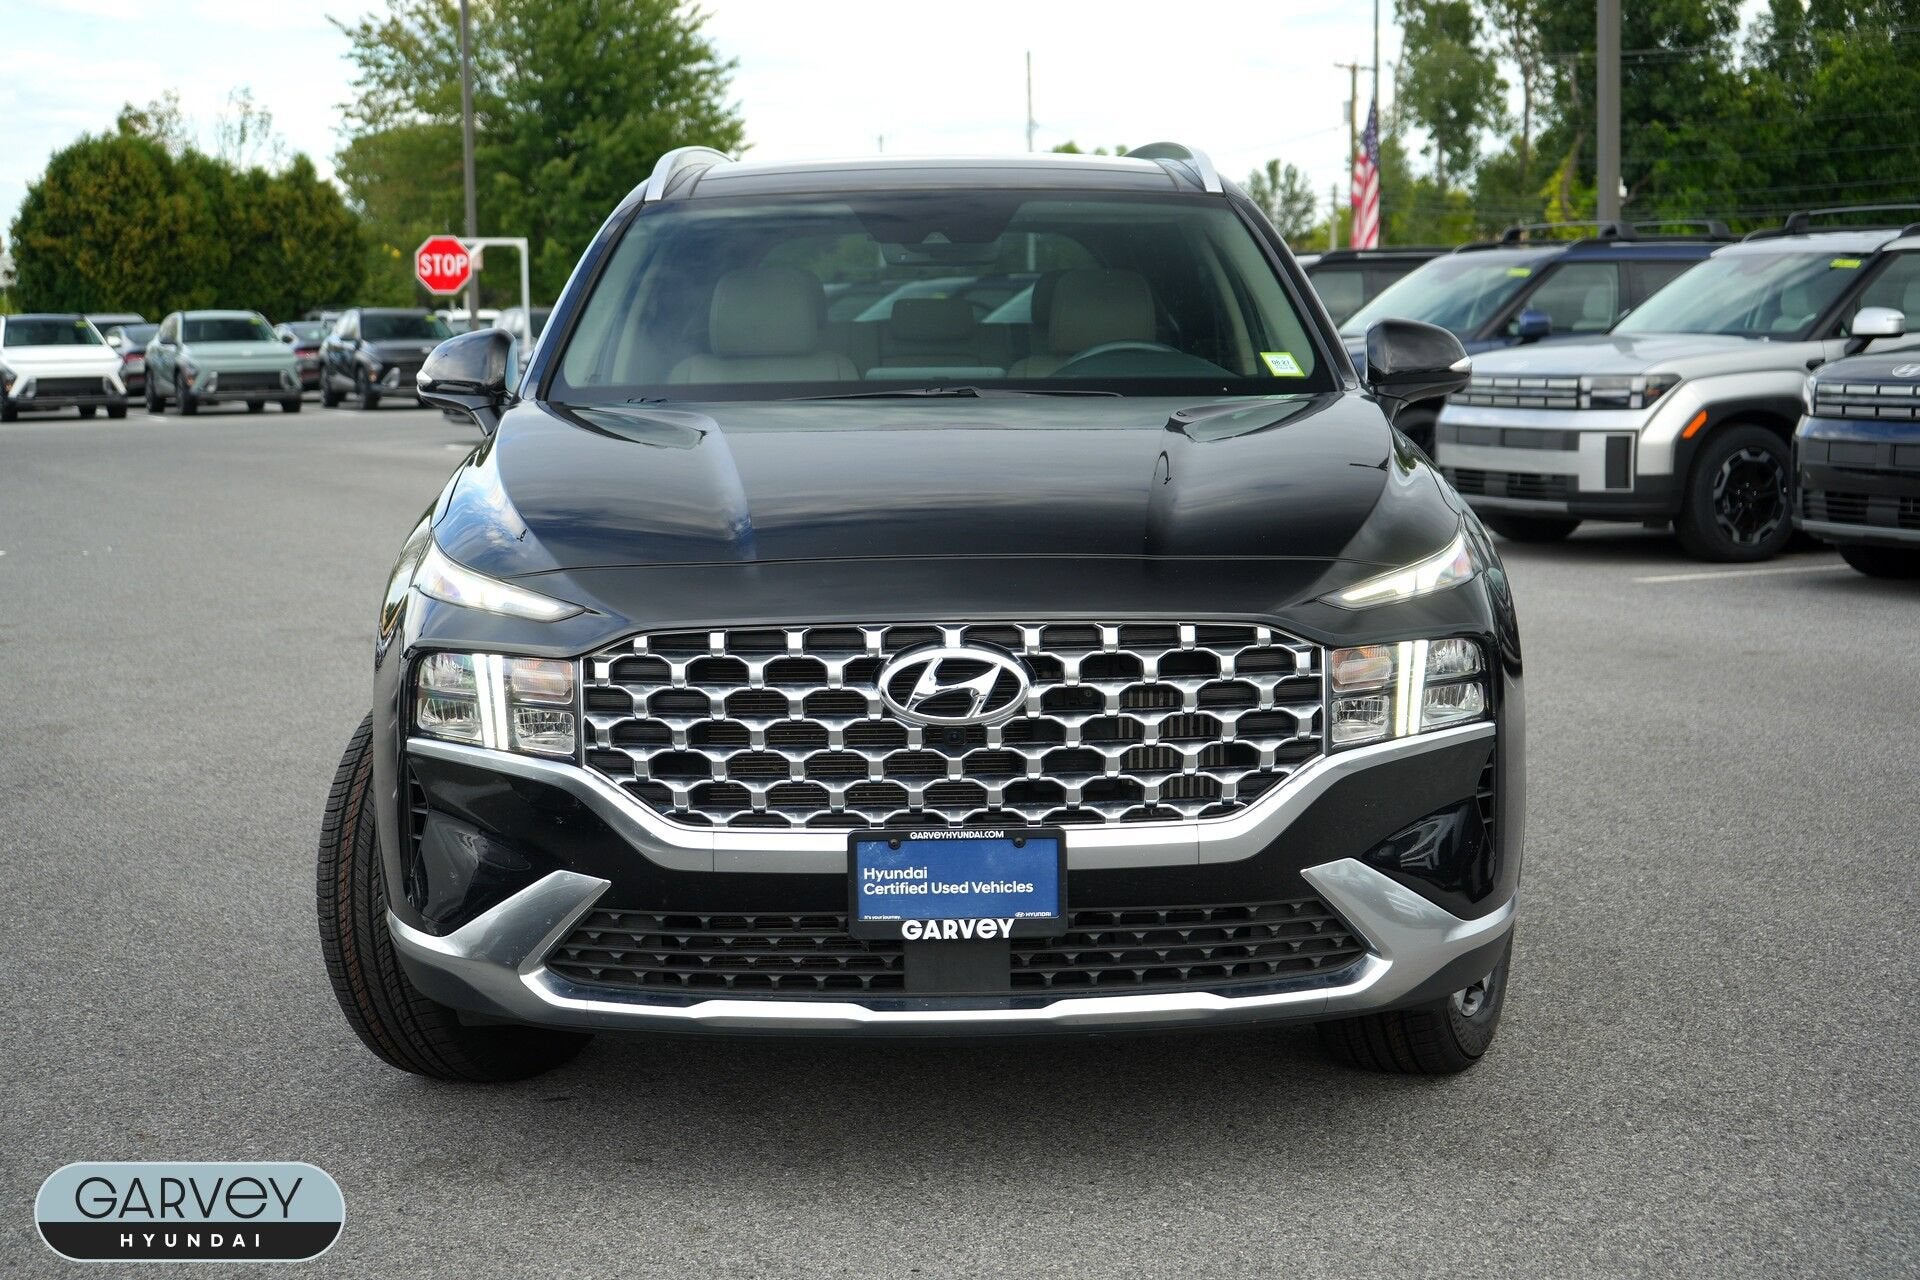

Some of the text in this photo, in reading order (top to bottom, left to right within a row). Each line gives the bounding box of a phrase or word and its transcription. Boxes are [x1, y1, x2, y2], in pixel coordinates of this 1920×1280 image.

[420, 253, 468, 277] STOP
[863, 866, 928, 882] Hyundai
[863, 880, 1034, 895] Certified Used Vehicles
